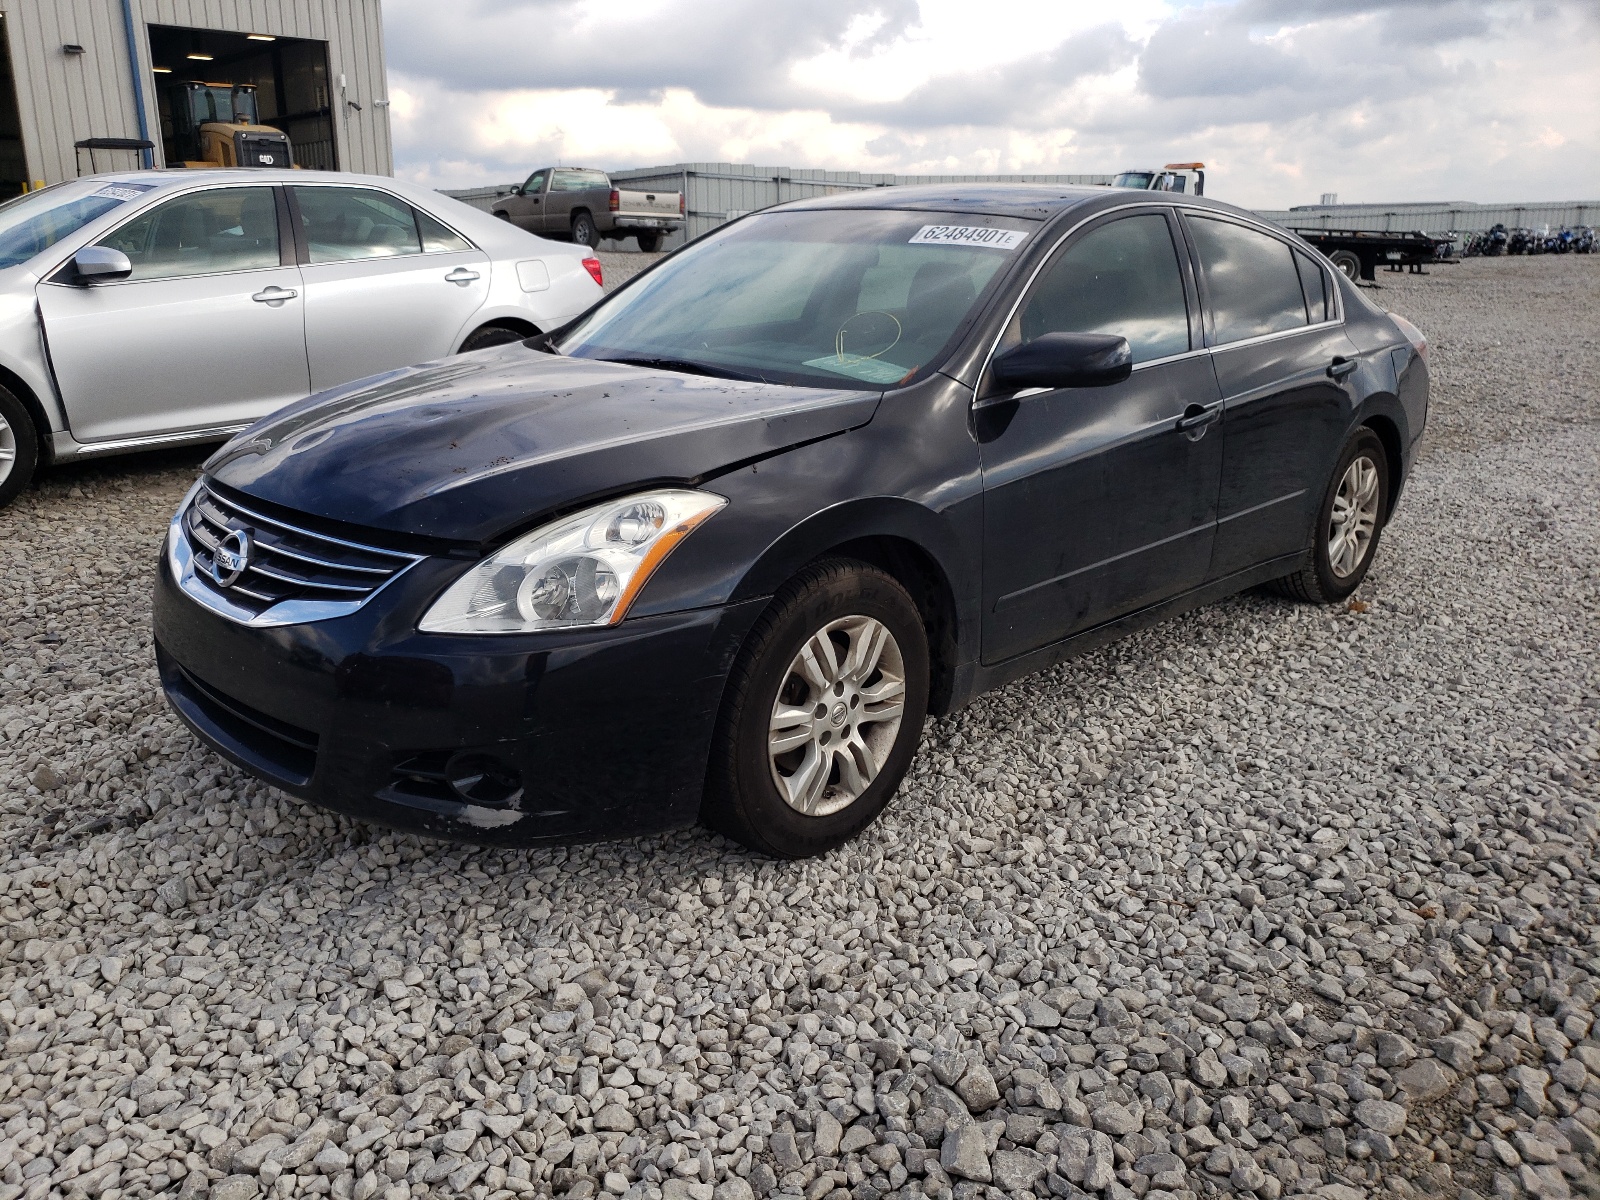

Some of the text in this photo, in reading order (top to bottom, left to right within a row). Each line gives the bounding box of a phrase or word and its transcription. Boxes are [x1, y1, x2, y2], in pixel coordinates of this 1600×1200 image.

[259, 154, 274, 165] CAT
[923, 226, 1009, 244] 62484901
[214, 552, 240, 569] SSAN
